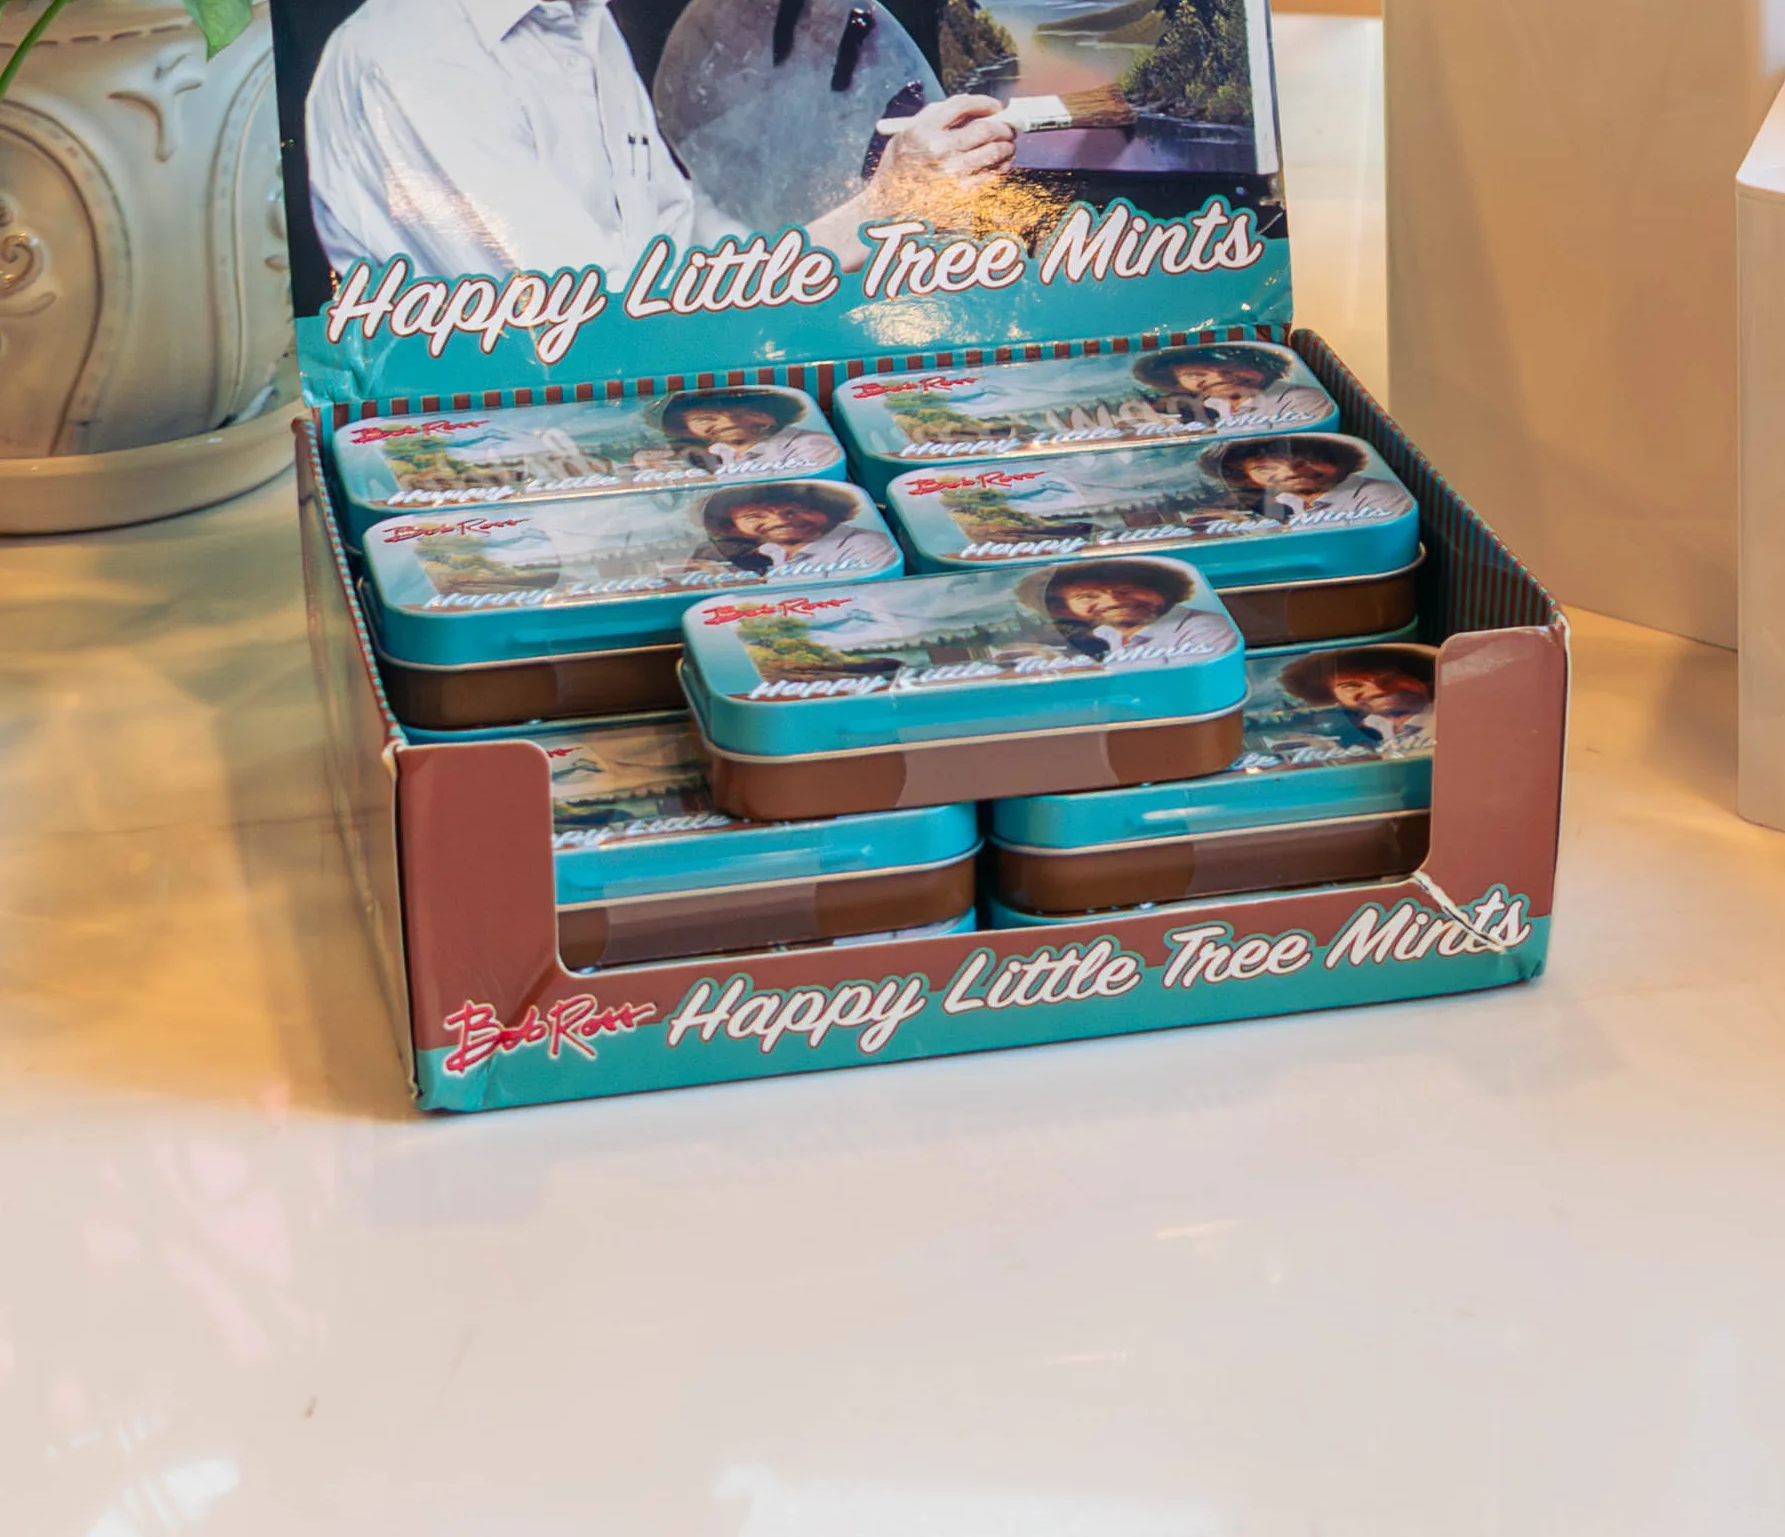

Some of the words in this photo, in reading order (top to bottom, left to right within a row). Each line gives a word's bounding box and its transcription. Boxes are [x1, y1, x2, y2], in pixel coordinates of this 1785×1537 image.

[326, 257, 606, 363] Happy
[624, 228, 840, 319] Little
[864, 219, 1026, 299] Tree
[1040, 200, 1266, 287] Mints
[444, 1000, 547, 1074] Bob
[547, 994, 657, 1058] Ross
[667, 977, 927, 1056] Happy
[942, 940, 1142, 1016] Little
[1162, 925, 1311, 990] Tree
[1326, 889, 1531, 970] Mints
